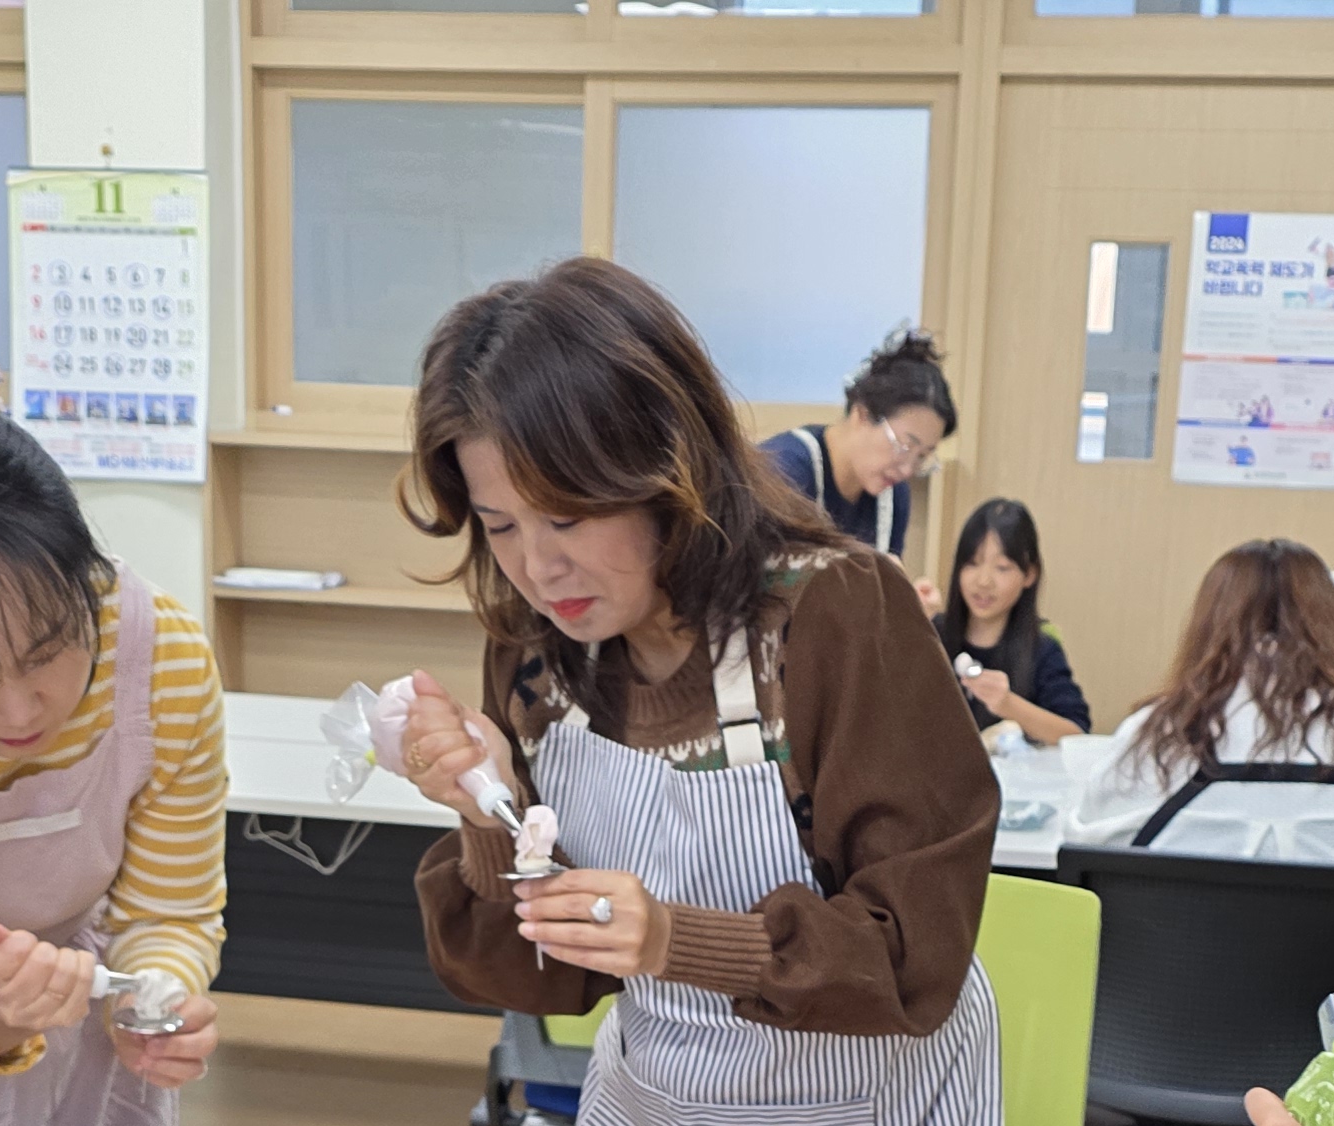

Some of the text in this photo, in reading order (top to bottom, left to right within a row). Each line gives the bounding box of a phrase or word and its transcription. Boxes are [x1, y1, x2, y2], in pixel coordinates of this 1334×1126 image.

[92, 179, 124, 214] 11
[56, 265, 67, 282] 3
[80, 266, 92, 282] 4
[106, 266, 117, 284] 5
[130, 267, 141, 284] 6
[154, 267, 166, 287] 7
[54, 294, 72, 312] 10
[79, 296, 96, 314] 11
[103, 295, 122, 314] 12
[128, 297, 147, 315] 13
[152, 297, 170, 317] 14
